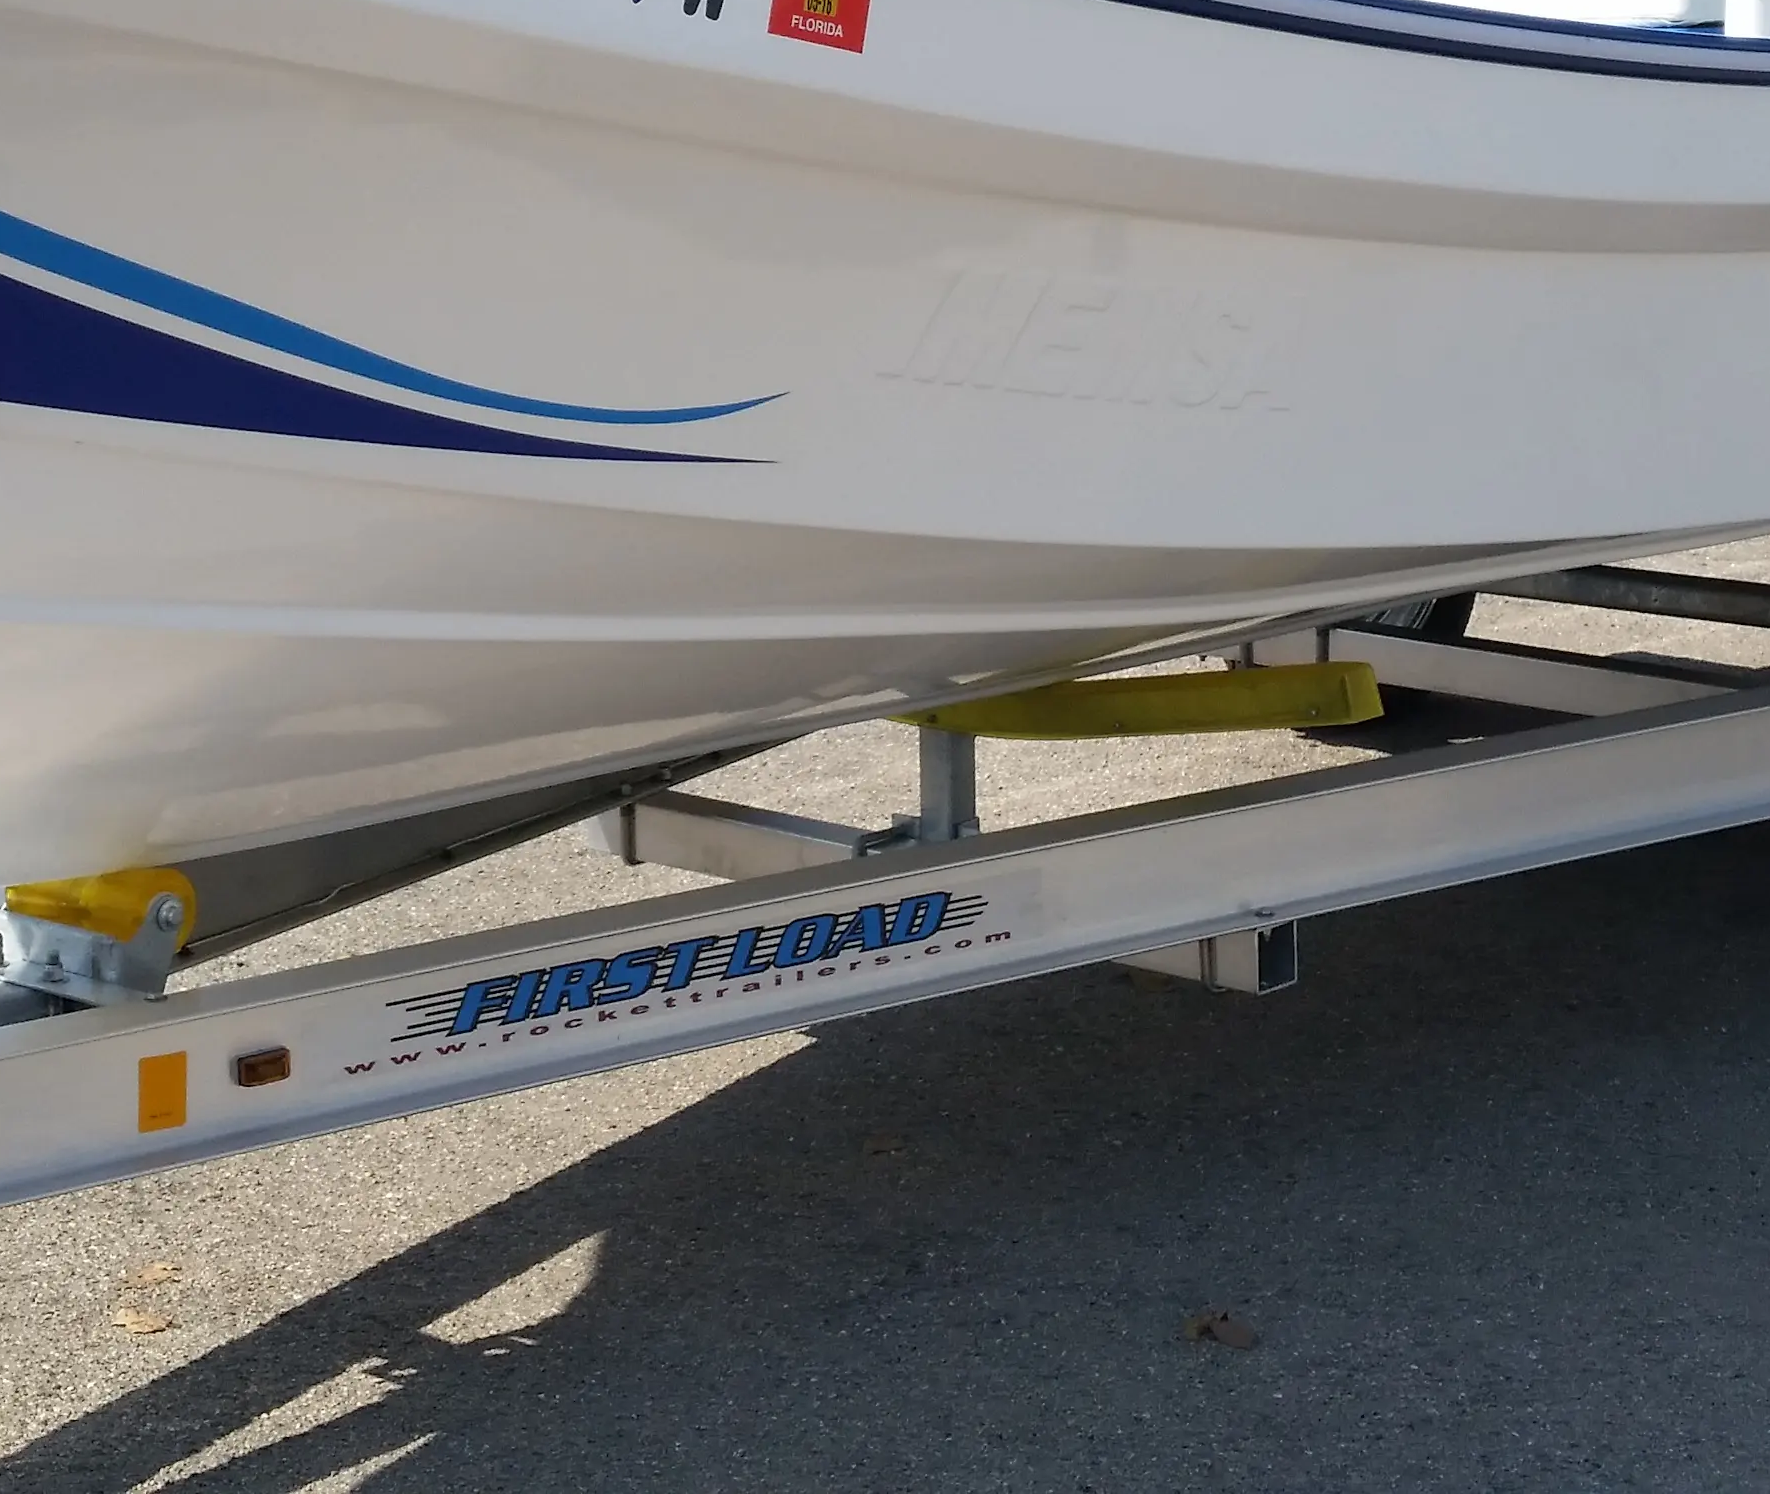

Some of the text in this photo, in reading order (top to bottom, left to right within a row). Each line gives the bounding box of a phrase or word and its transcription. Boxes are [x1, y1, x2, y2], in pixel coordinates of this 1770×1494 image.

[791, 14, 843, 37] FLORIDA
[344, 930, 1011, 1076] www.rockettrailers.com
[445, 892, 952, 1038] FIRST LOAD
